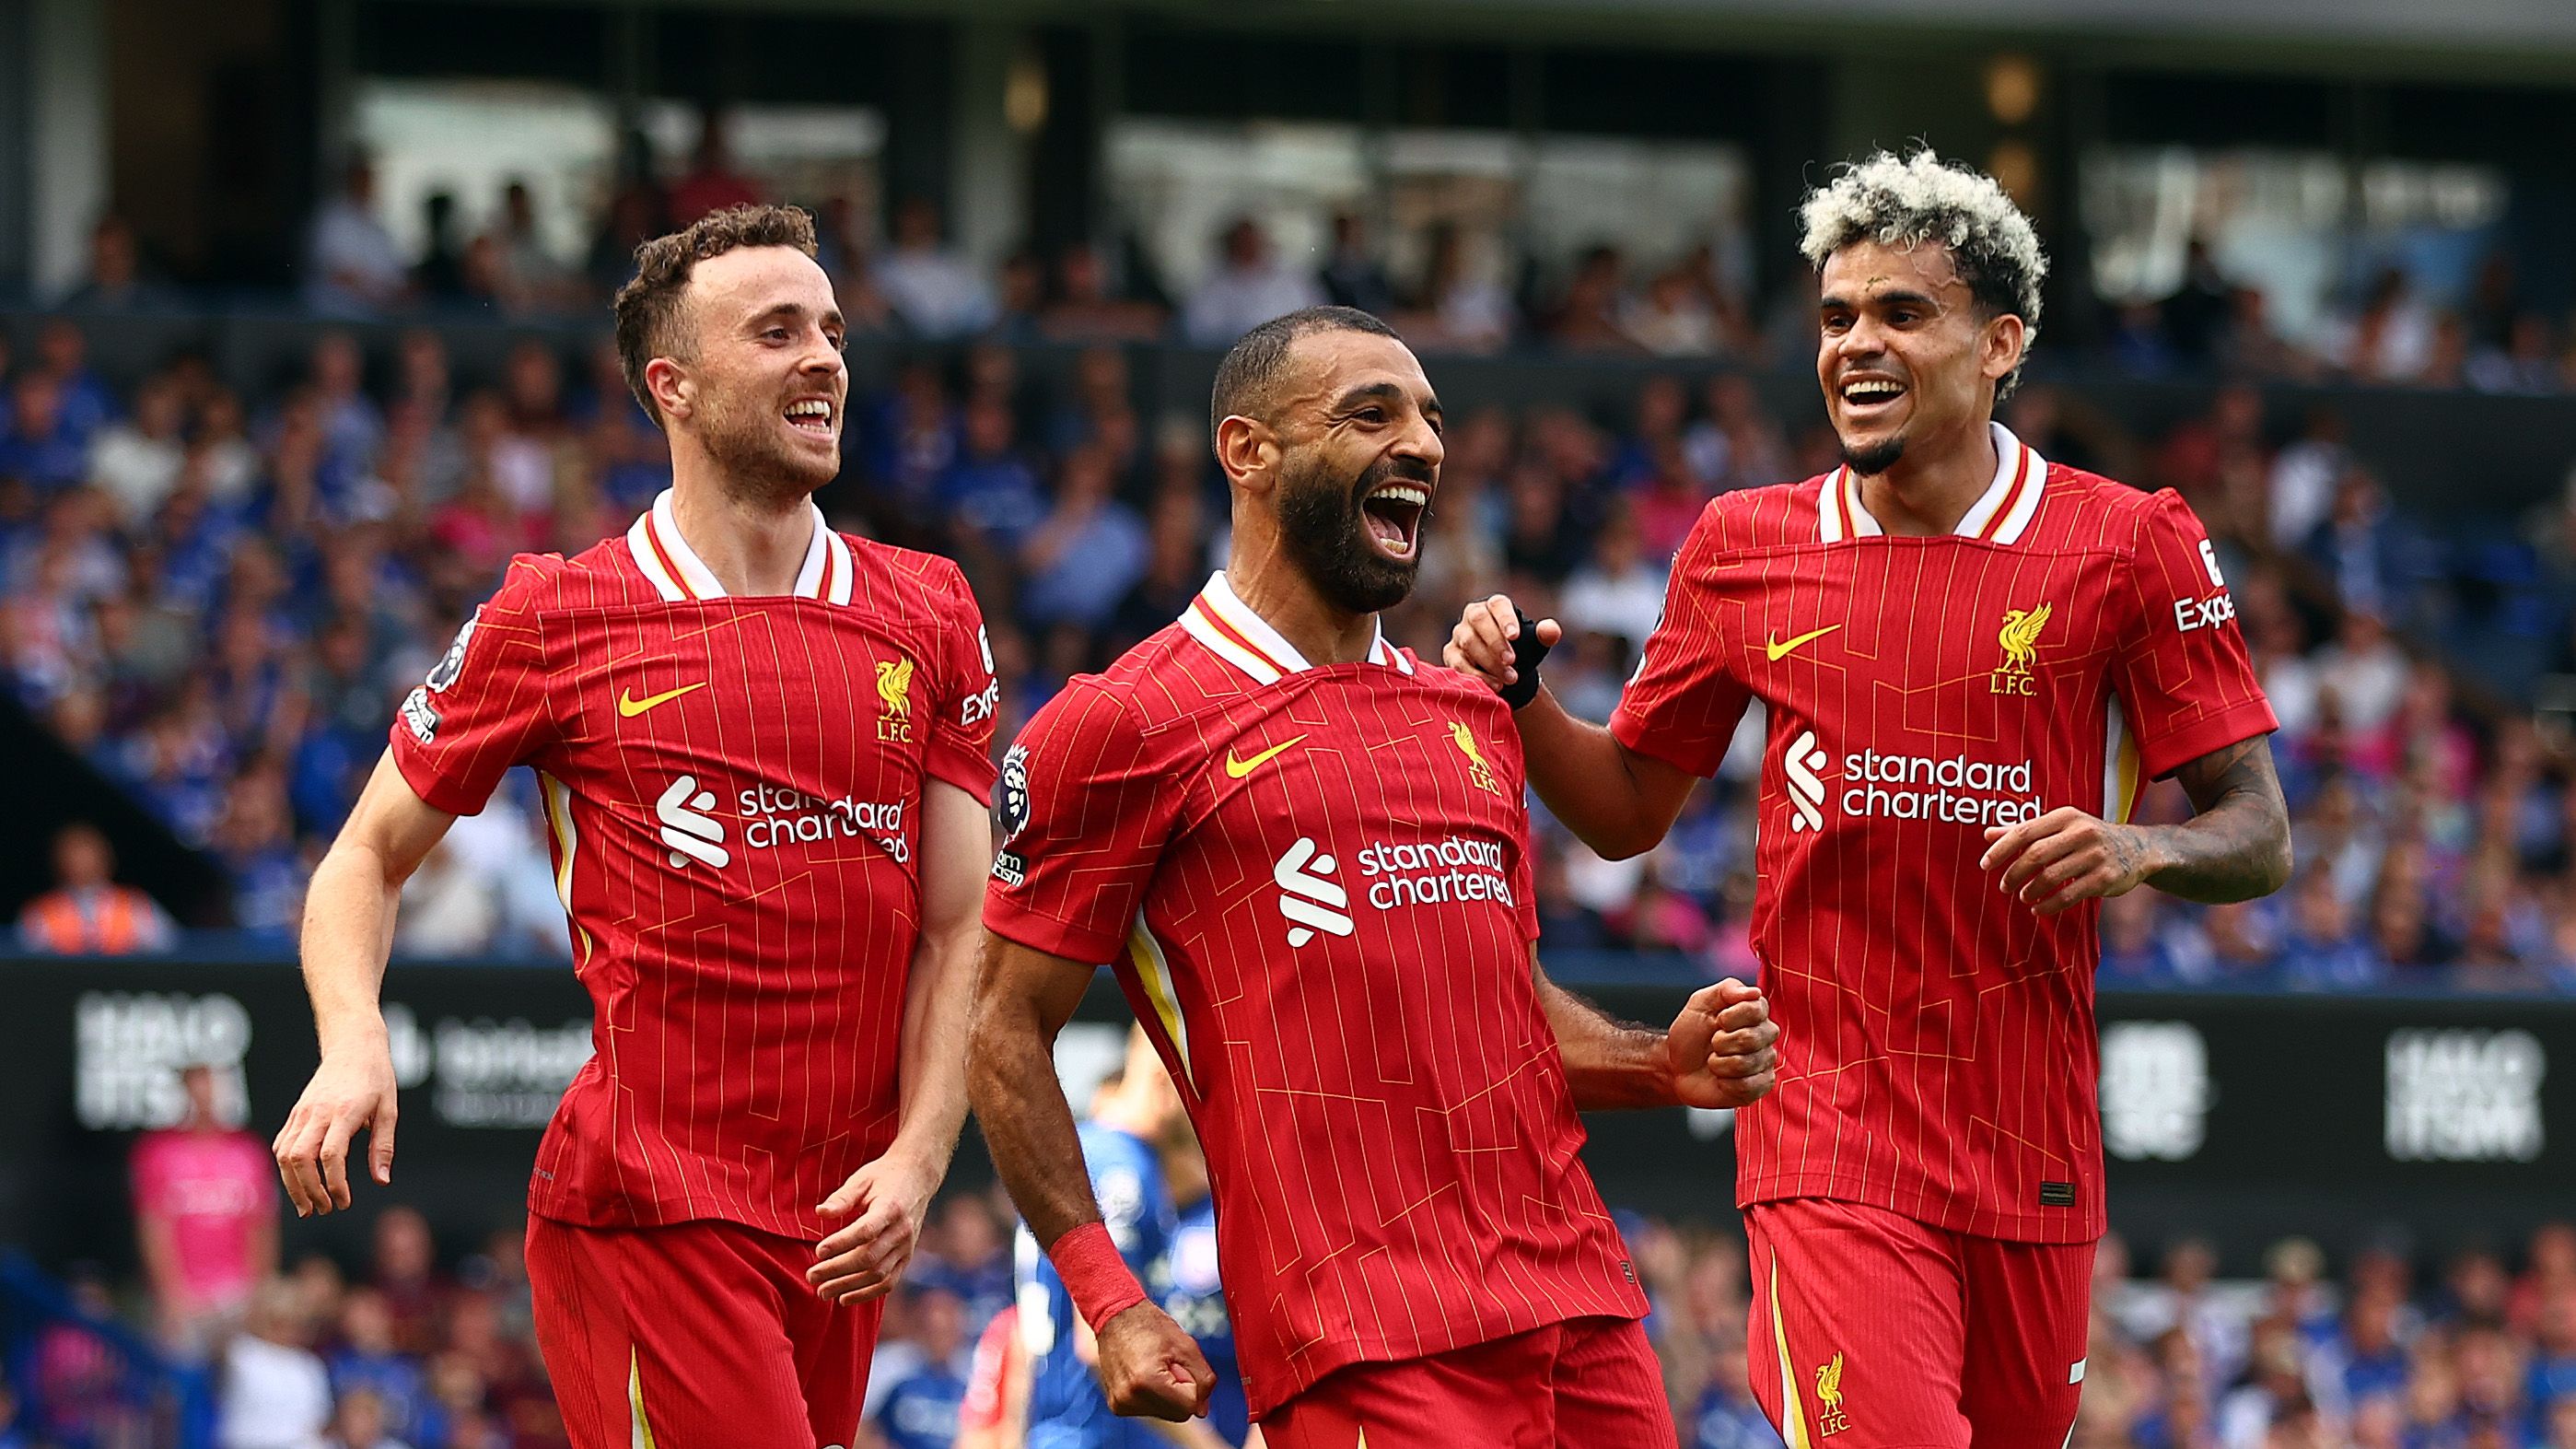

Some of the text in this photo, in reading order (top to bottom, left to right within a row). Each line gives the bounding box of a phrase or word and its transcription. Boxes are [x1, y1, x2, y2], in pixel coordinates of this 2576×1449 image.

[1990, 673, 2037, 696] L.F.C.
[877, 720, 914, 743] L.F.C.
[1844, 748, 2031, 792] standard
[1843, 783, 2041, 826] chartered
[1358, 835, 1503, 876] standard
[1369, 868, 1514, 910] chartered
